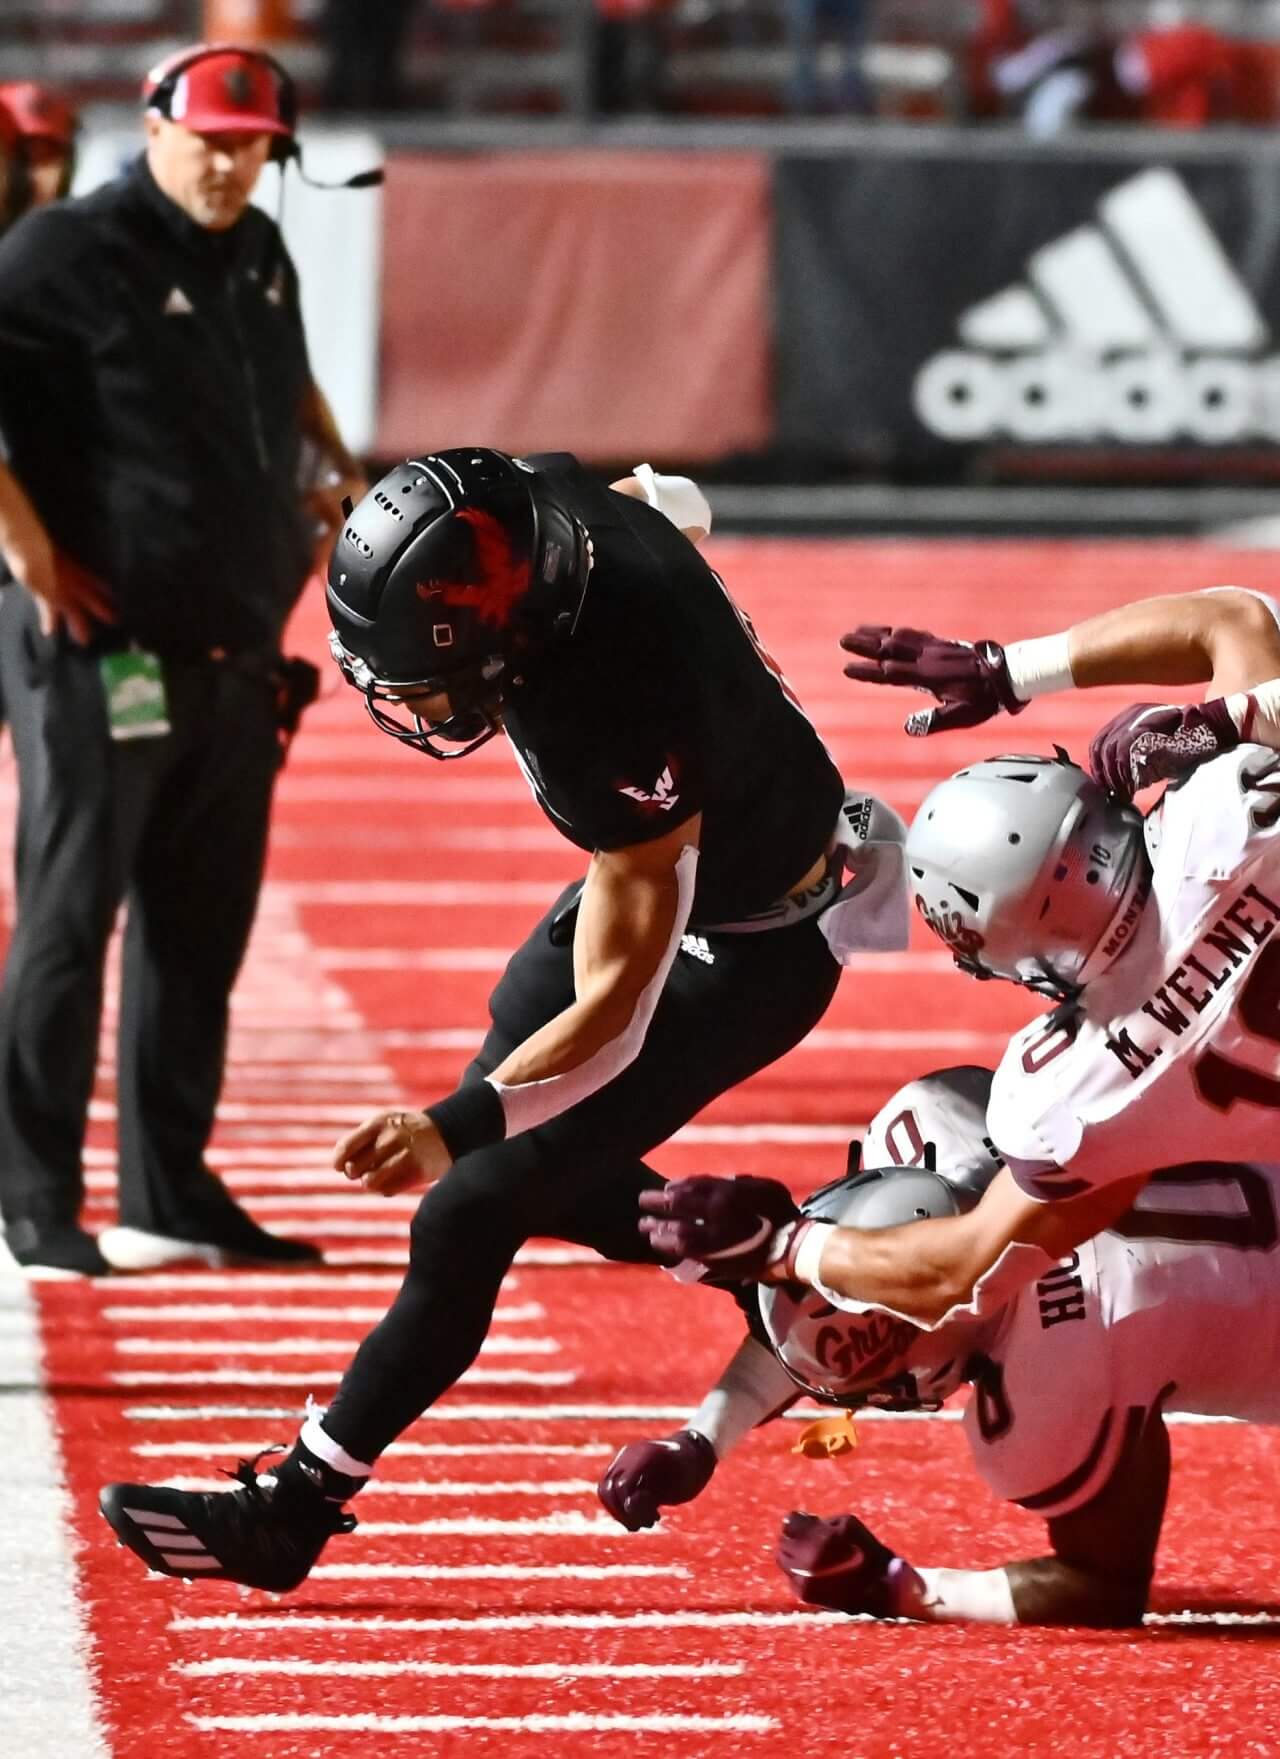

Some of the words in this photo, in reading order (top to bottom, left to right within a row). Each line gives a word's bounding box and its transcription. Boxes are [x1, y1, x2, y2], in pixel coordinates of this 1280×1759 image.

[859, 798, 873, 840] adidas
[1089, 844, 1111, 868] 10
[1105, 1027, 1163, 1079] M.
